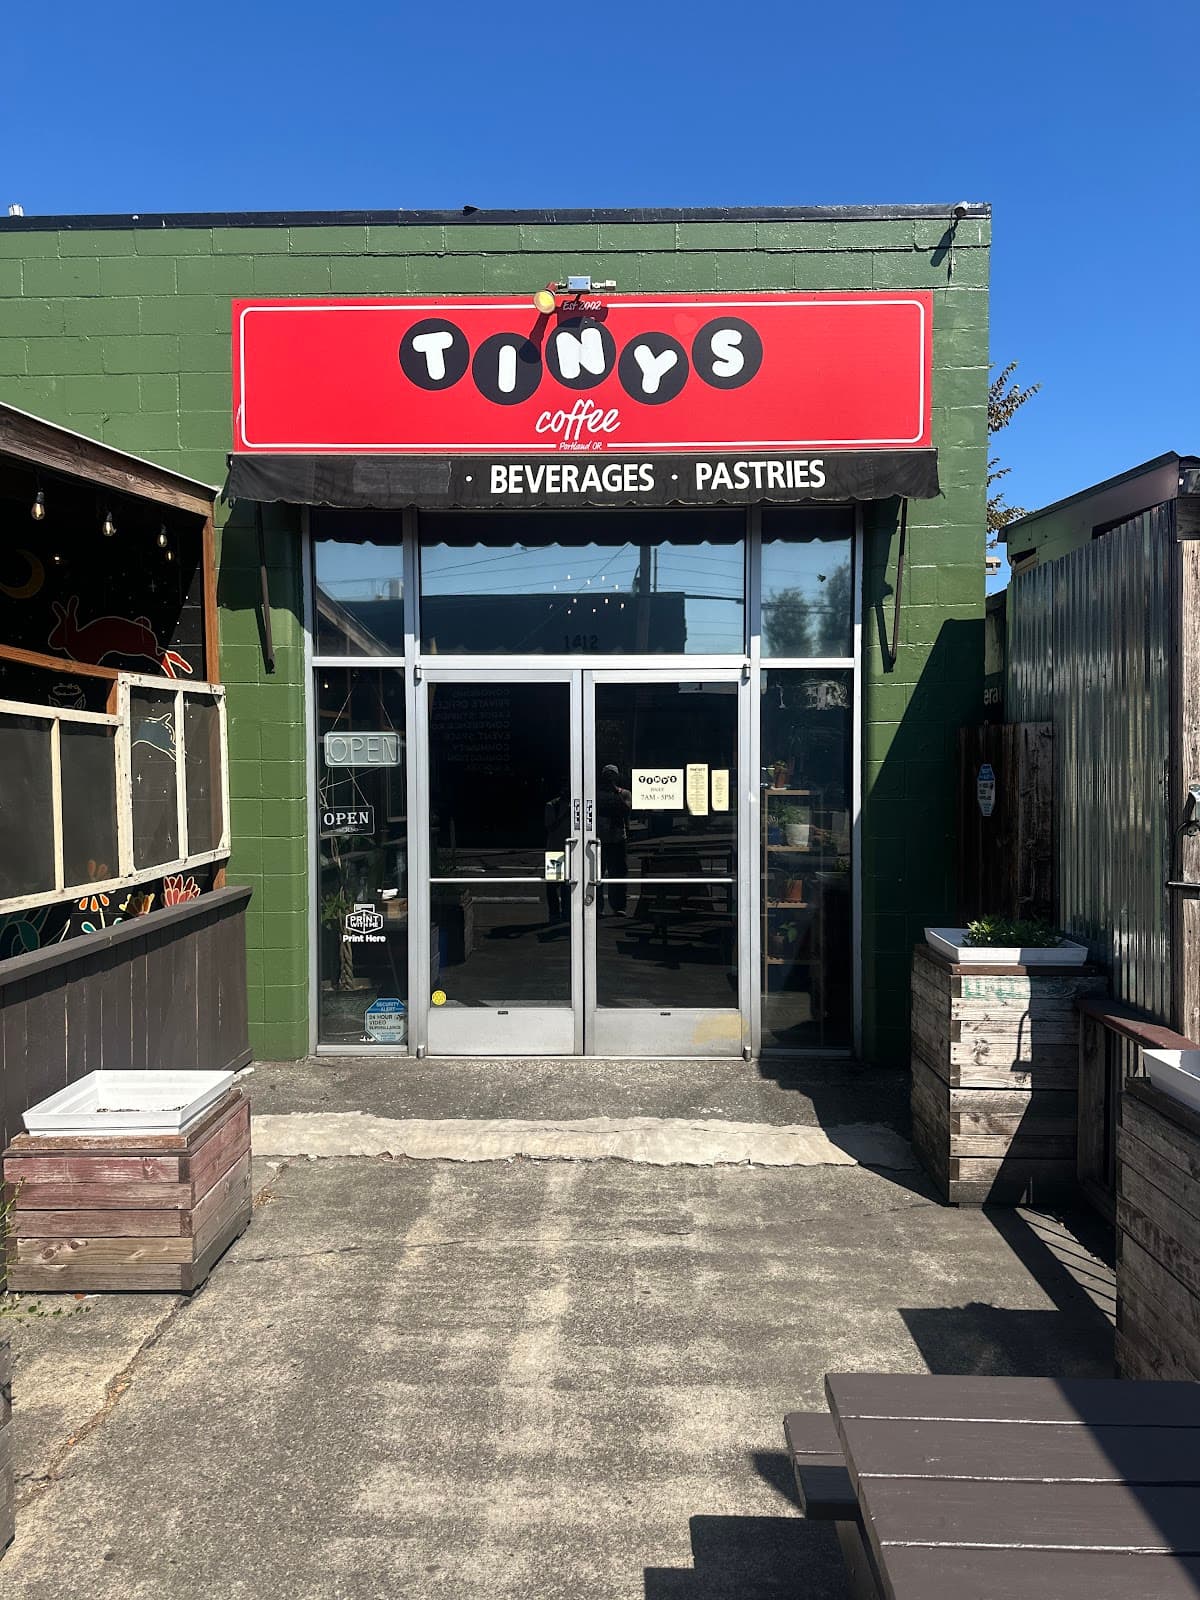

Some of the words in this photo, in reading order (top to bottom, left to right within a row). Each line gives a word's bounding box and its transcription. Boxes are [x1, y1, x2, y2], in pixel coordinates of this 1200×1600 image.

[562, 301, 577, 311] Est
[578, 300, 602, 311] 2002
[412, 327, 745, 395] TINYS
[535, 399, 621, 440] coffee
[559, 441, 592, 450] Portland
[592, 441, 602, 450] OR
[490, 463, 655, 493] BEVERAGES
[695, 459, 826, 489] PASTRIES
[563, 634, 599, 649] 1412
[329, 736, 397, 762] OPEN
[323, 811, 370, 826] OPEN
[350, 915, 379, 923] PRINT
[343, 934, 364, 942] Print
[366, 934, 386, 942] Here
